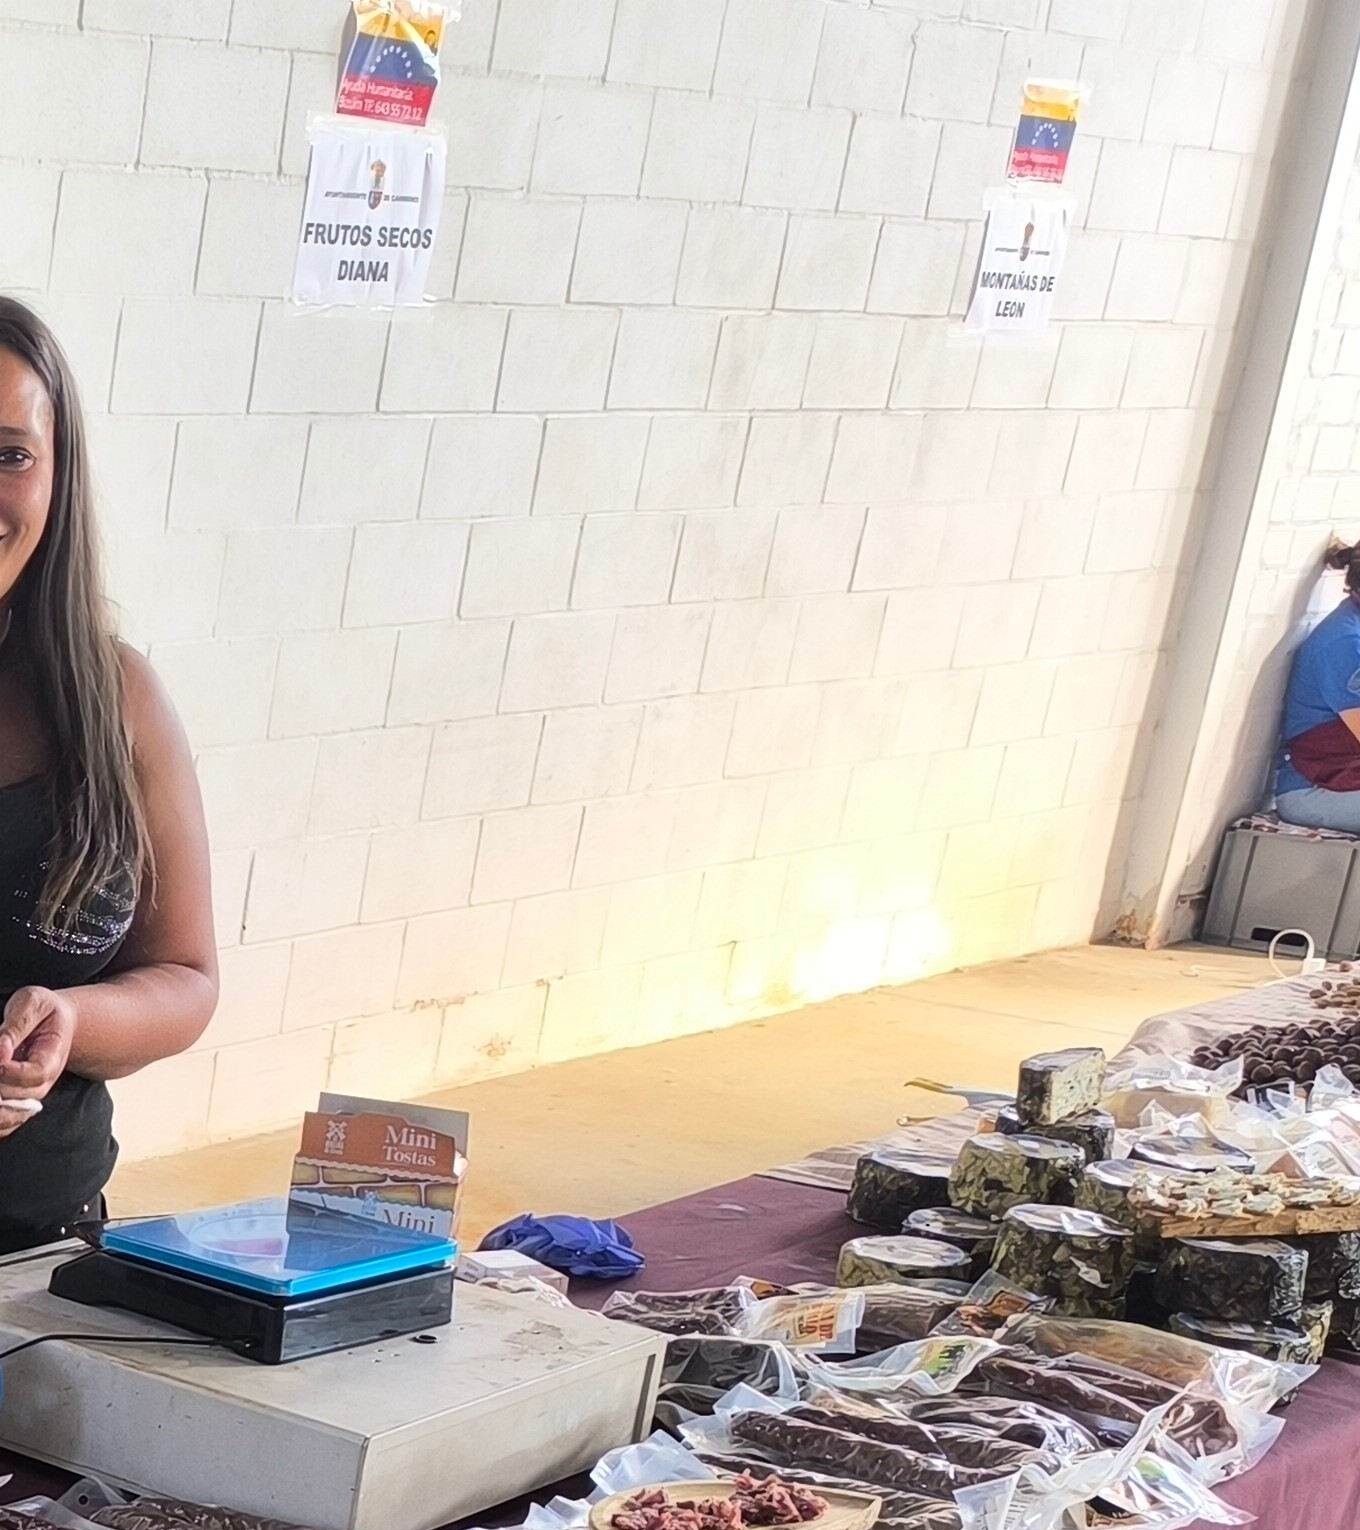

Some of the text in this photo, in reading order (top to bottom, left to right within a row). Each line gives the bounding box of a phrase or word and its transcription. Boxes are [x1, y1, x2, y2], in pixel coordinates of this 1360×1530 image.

[303, 222, 433, 250] FRUTOS SECOS
[337, 260, 389, 282] DIANA
[980, 270, 1055, 292] MONTAÑAS DE
[384, 1124, 437, 1150] Mini
[382, 1145, 436, 1167] Tostas
